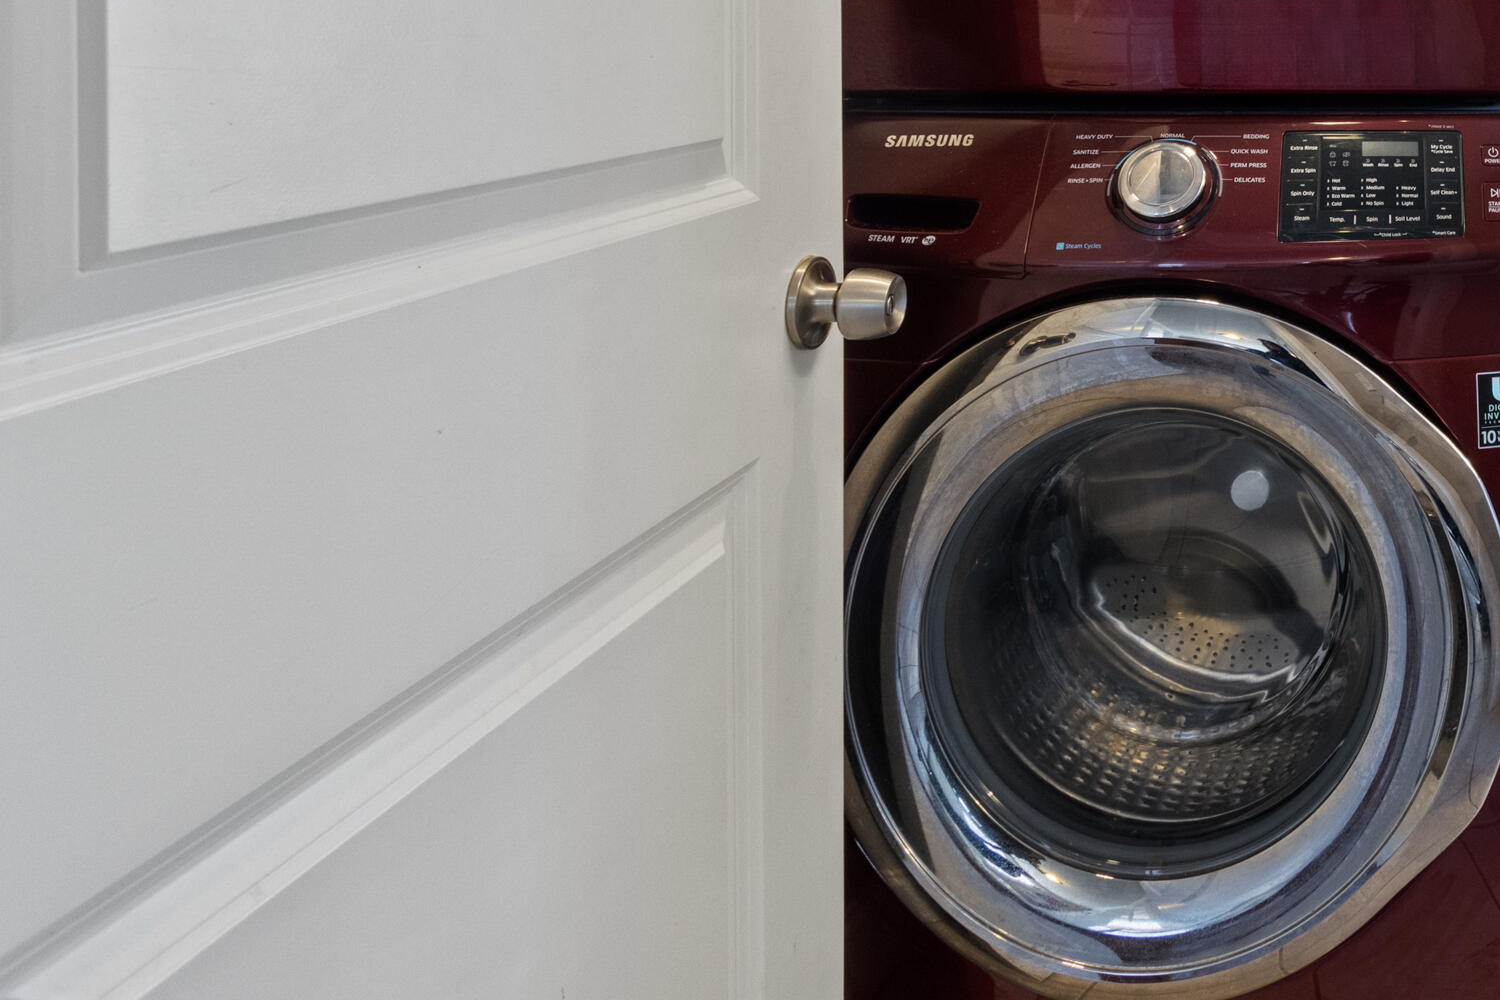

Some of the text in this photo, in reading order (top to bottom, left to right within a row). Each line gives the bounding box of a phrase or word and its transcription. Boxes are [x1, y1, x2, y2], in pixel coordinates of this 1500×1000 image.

[884, 134, 975, 148] SAMSUNG
[868, 234, 896, 243] STEAM
[1481, 430, 1497, 444] 10
